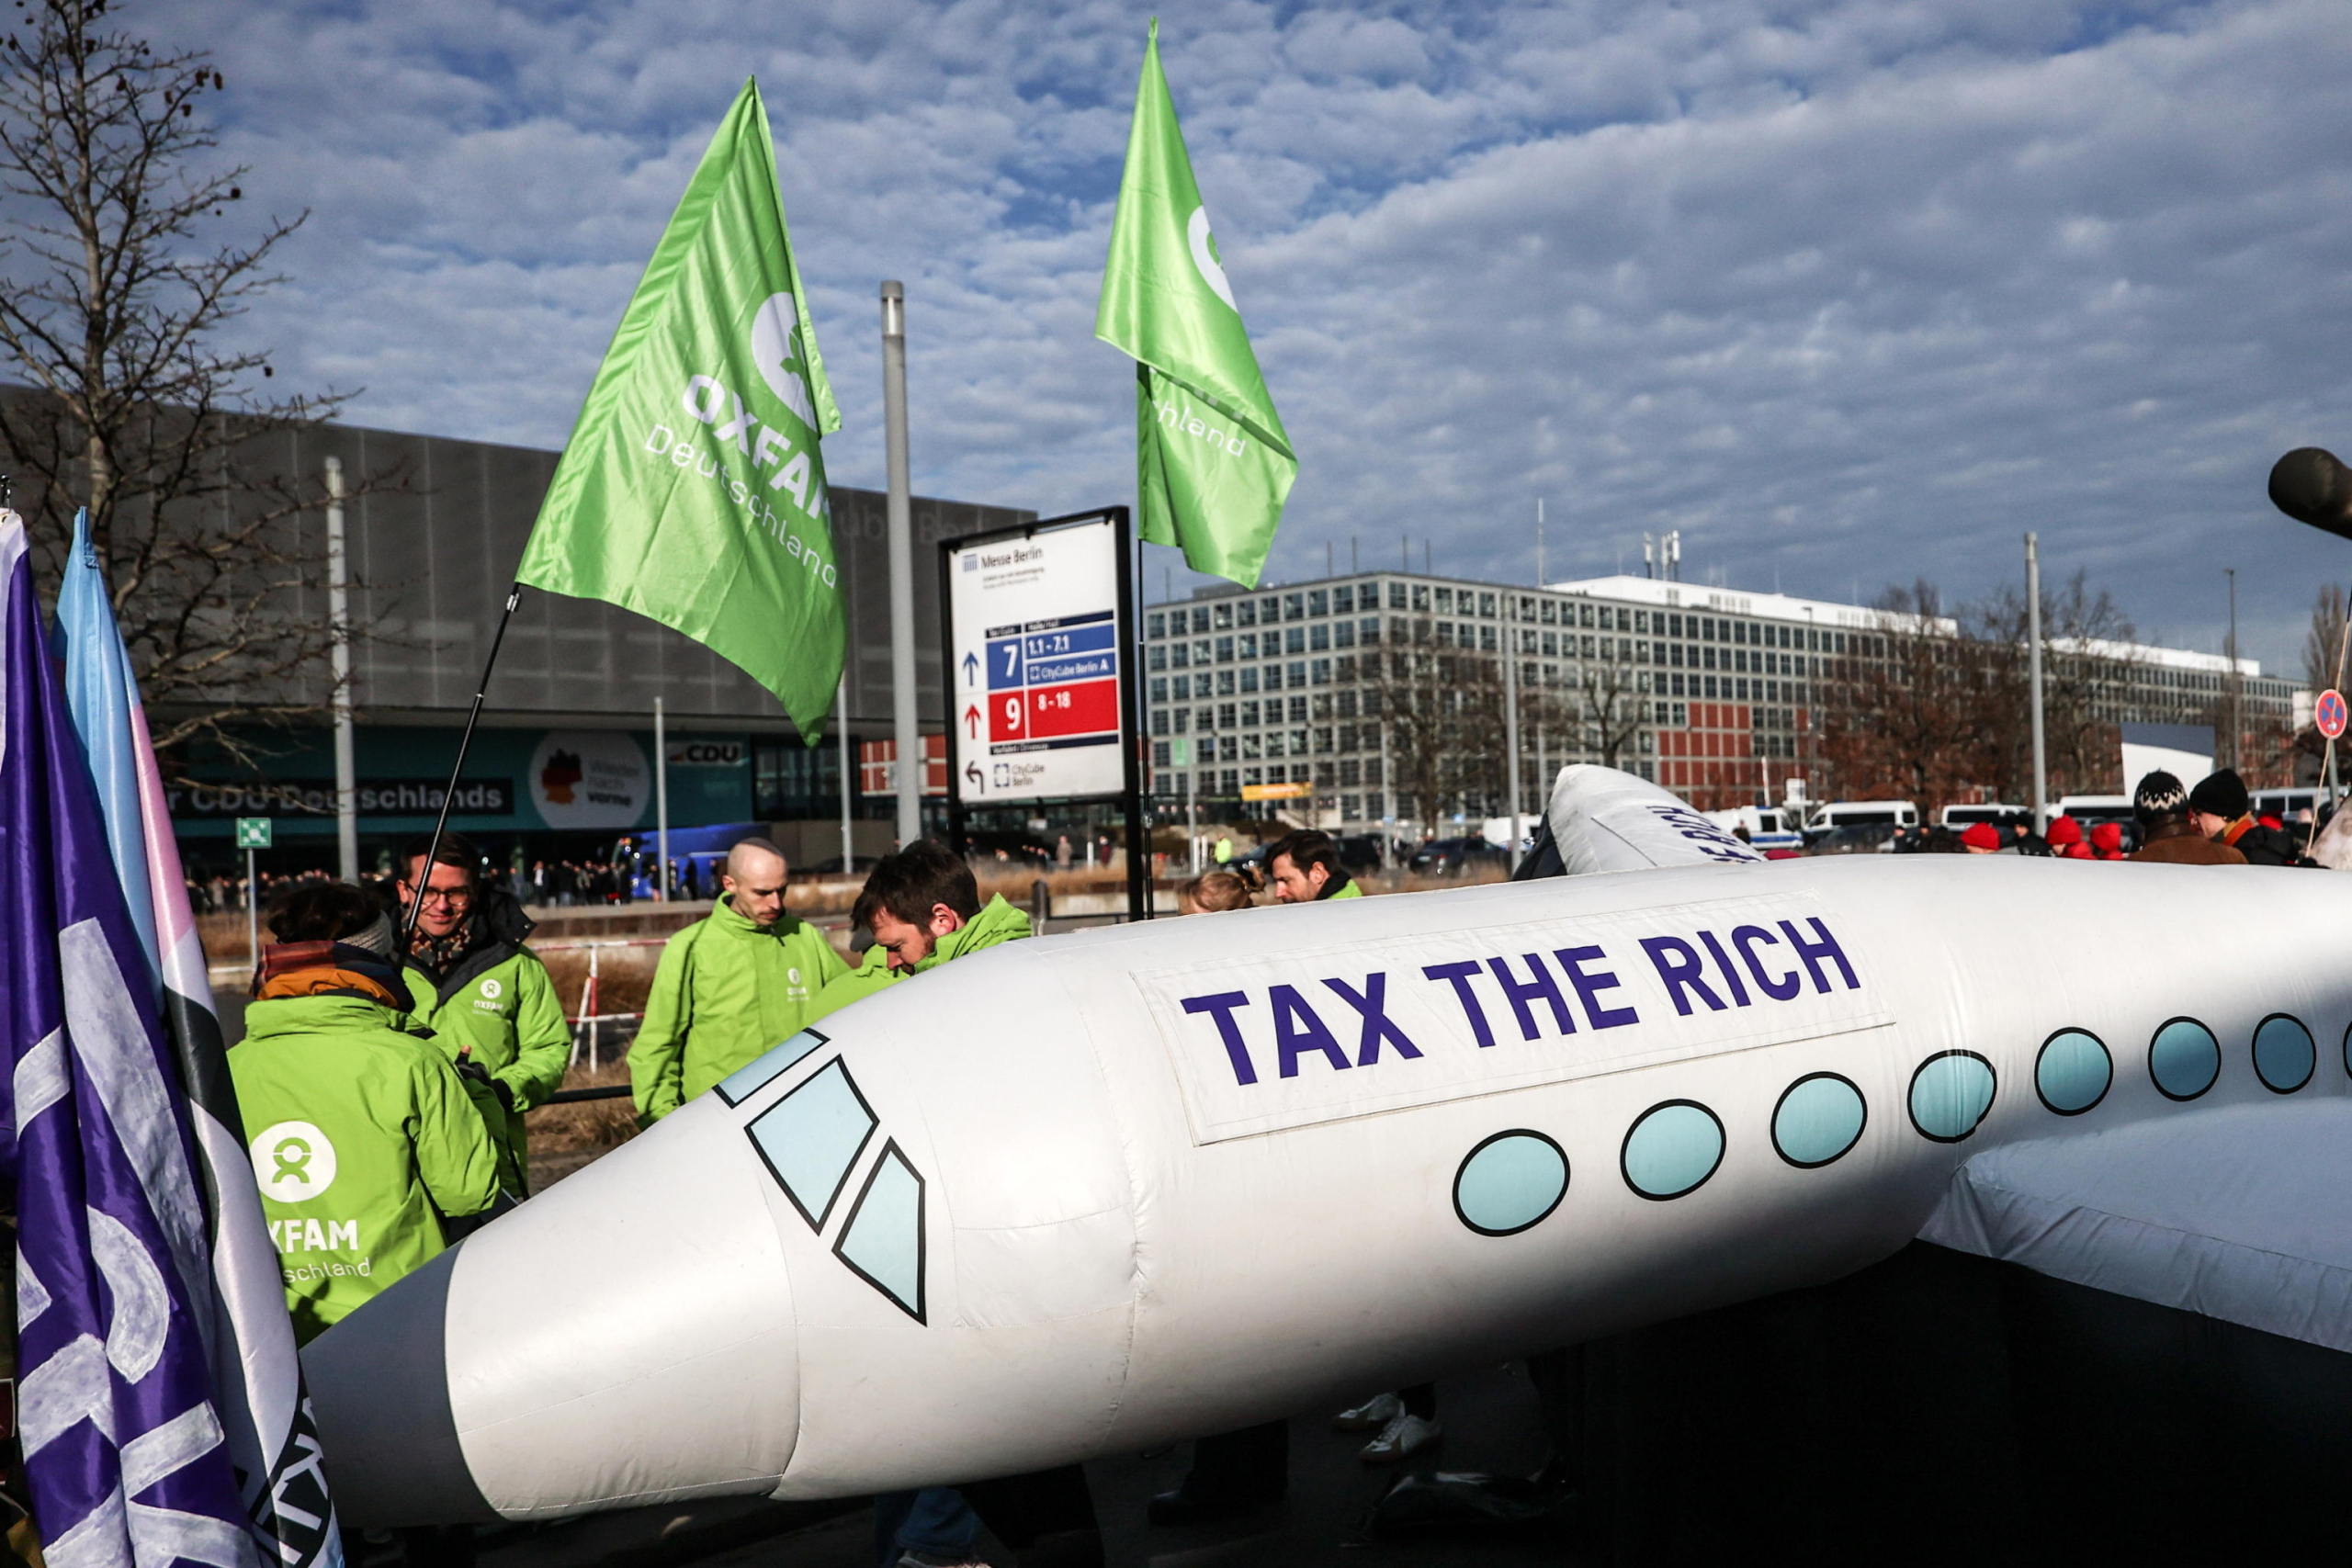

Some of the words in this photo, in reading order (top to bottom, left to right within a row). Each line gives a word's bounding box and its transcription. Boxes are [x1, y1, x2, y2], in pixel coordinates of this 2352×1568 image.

[1155, 400, 1248, 458] hland
[981, 553, 1012, 569] Messe
[1013, 546, 1043, 562] Berlin
[1002, 644, 1018, 678] 7
[1041, 663, 1075, 682] CityCube
[1075, 661, 1099, 675] Berlin
[1099, 658, 1109, 671] A
[1037, 693, 1046, 710] 8
[1055, 690, 1071, 707] 18
[1006, 698, 1020, 731] 9
[687, 744, 739, 762] CDU
[1012, 761, 1046, 776] CityCube
[1012, 776, 1034, 787] Berlin
[190, 783, 271, 812] CDU
[278, 783, 503, 812] Deuschlands
[1180, 971, 1424, 1088] TAX
[1421, 943, 1641, 1049] THE
[1638, 916, 1862, 1018] RICH
[266, 1219, 359, 1254] XFAM
[283, 1257, 372, 1284] schland
